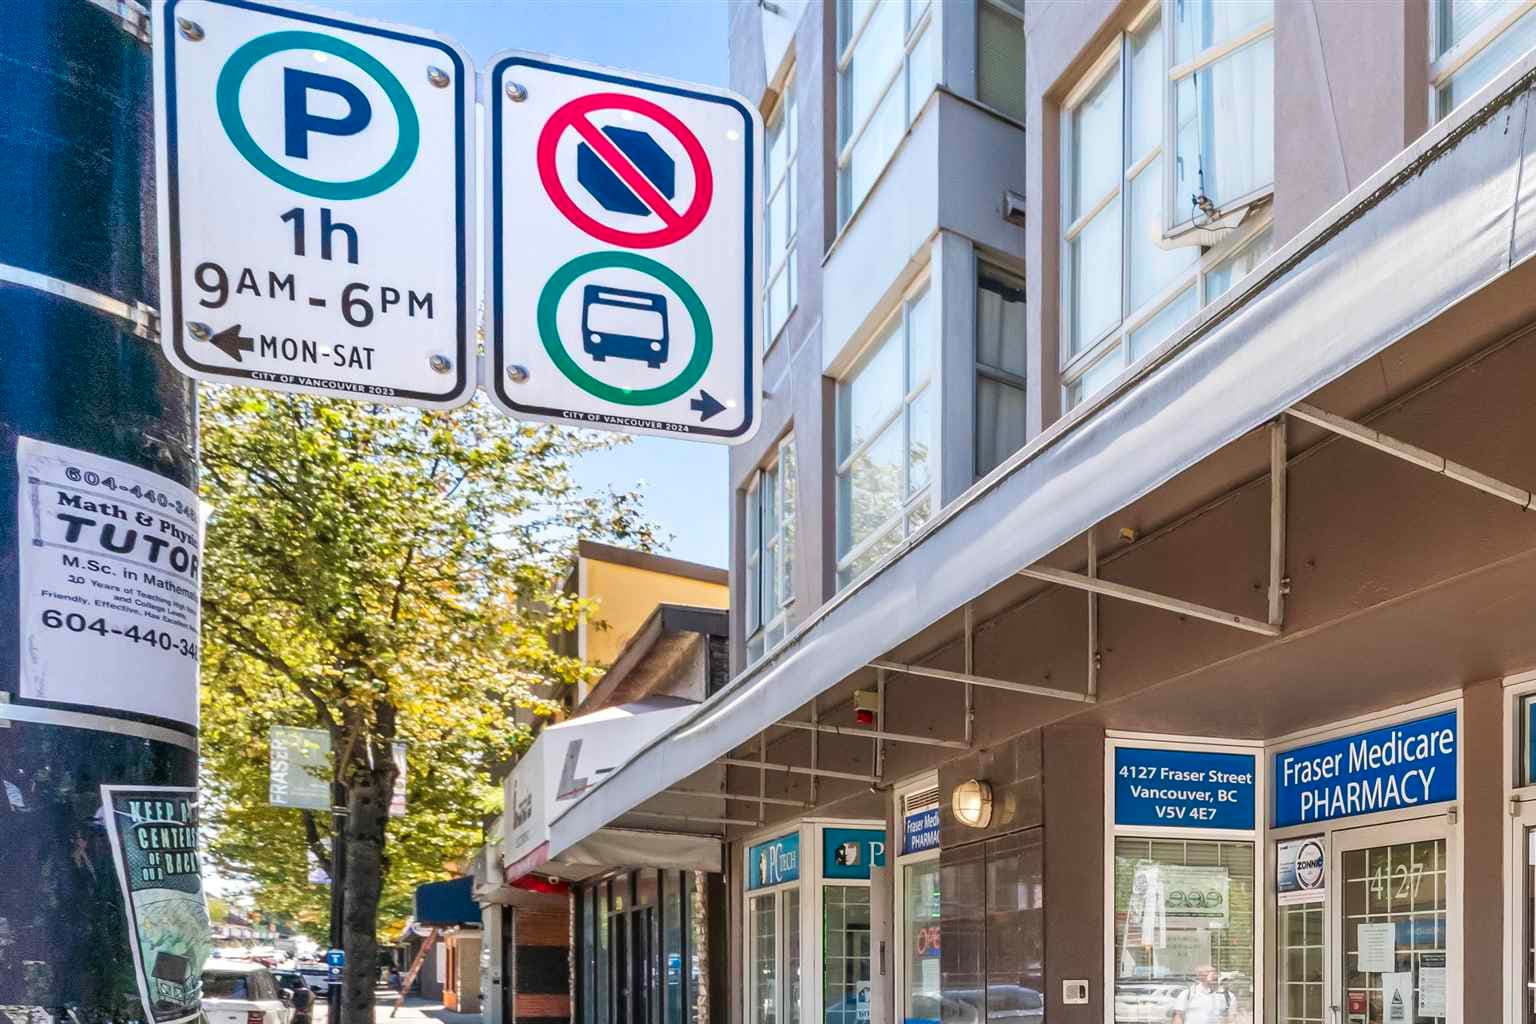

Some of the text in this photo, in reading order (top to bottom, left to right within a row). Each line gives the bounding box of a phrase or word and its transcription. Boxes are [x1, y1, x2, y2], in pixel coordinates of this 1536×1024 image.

[284, 67, 372, 160] P
[280, 207, 359, 265] 1h
[260, 335, 375, 370] MON-SAT
[251, 371, 395, 397] CITY OF VANCOUVER 2023
[563, 410, 690, 433] CITY OF VANCOUVER 2024
[57, 491, 128, 520] Math
[135, 511, 153, 527] &
[63, 554, 116, 576] M.Sc.
[123, 567, 138, 581] in
[67, 574, 85, 585] 20
[91, 579, 121, 593] Years
[123, 586, 133, 595] of
[113, 594, 132, 603] and
[1283, 728, 1454, 787] Fraser Medicare
[1119, 766, 1253, 784] 4127 Fraser Street
[1130, 785, 1238, 803] Vancouver, BC
[1300, 766, 1436, 822] PHARMACY
[129, 801, 174, 822] KEEP
[1155, 805, 1217, 820] V5V 4E7
[907, 819, 924, 834] Fraser
[1370, 863, 1424, 900] 4127
